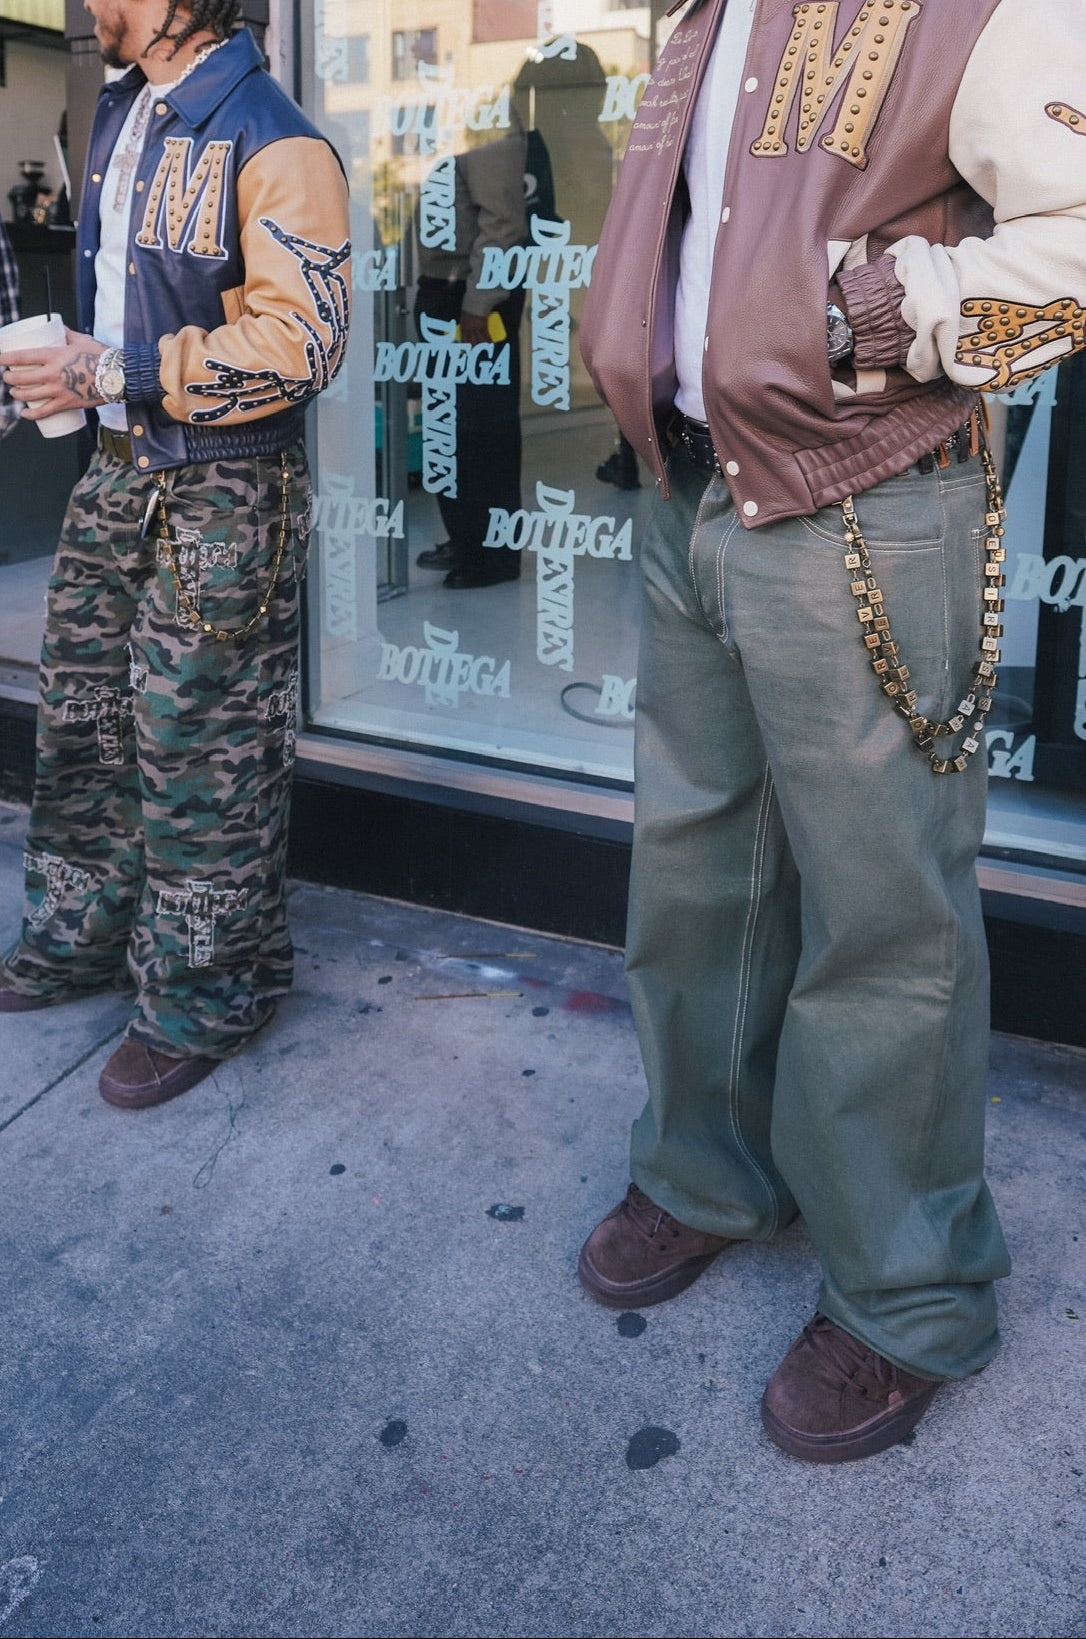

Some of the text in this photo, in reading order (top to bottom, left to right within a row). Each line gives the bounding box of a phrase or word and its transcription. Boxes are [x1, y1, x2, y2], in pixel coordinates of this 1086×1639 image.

[752, 0, 924, 171] M
[135, 136, 233, 261] M
[476, 244, 599, 290] BOTTE
[530, 213, 571, 412] DESIRES
[374, 341, 511, 386] BOTTEGA
[420, 312, 458, 499] DESIRES
[312, 497, 404, 539] TTEGA
[483, 508, 633, 561] BOTTEGA
[536, 481, 576, 672] DESIRES
[376, 643, 511, 698] BOTTEGA
